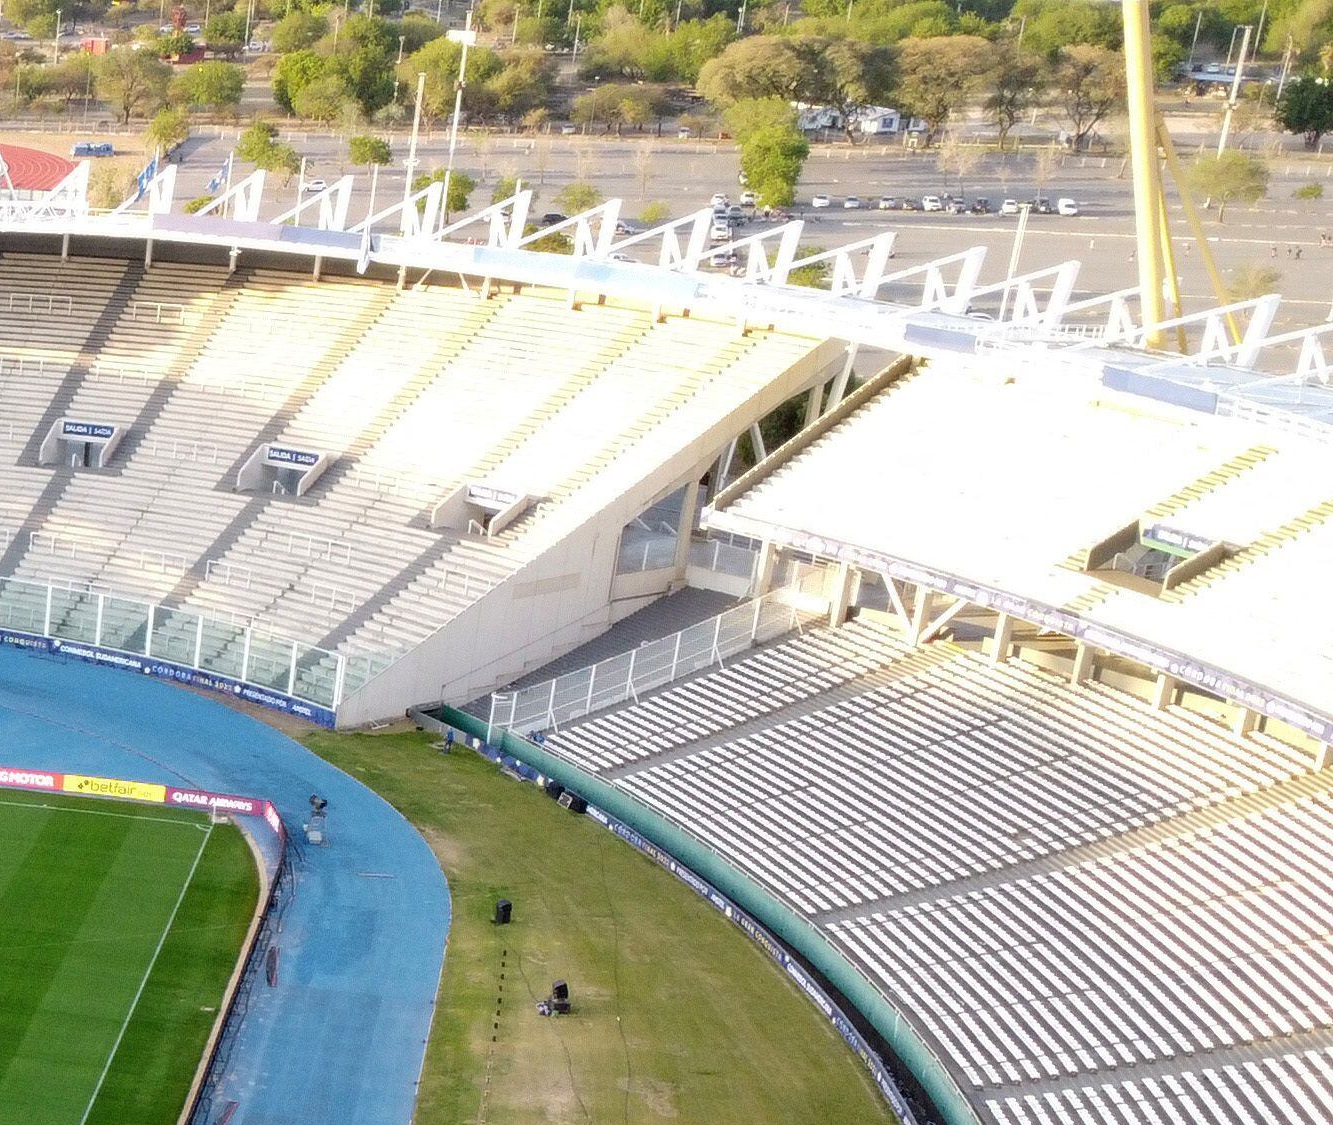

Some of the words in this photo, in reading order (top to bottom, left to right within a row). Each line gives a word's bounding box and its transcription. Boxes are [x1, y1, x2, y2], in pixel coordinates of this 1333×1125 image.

[8, 772, 54, 787] MOTOR
[90, 779, 136, 796] betfair
[172, 791, 208, 804] QATAR
[208, 797, 253, 812] AIRWAYS
